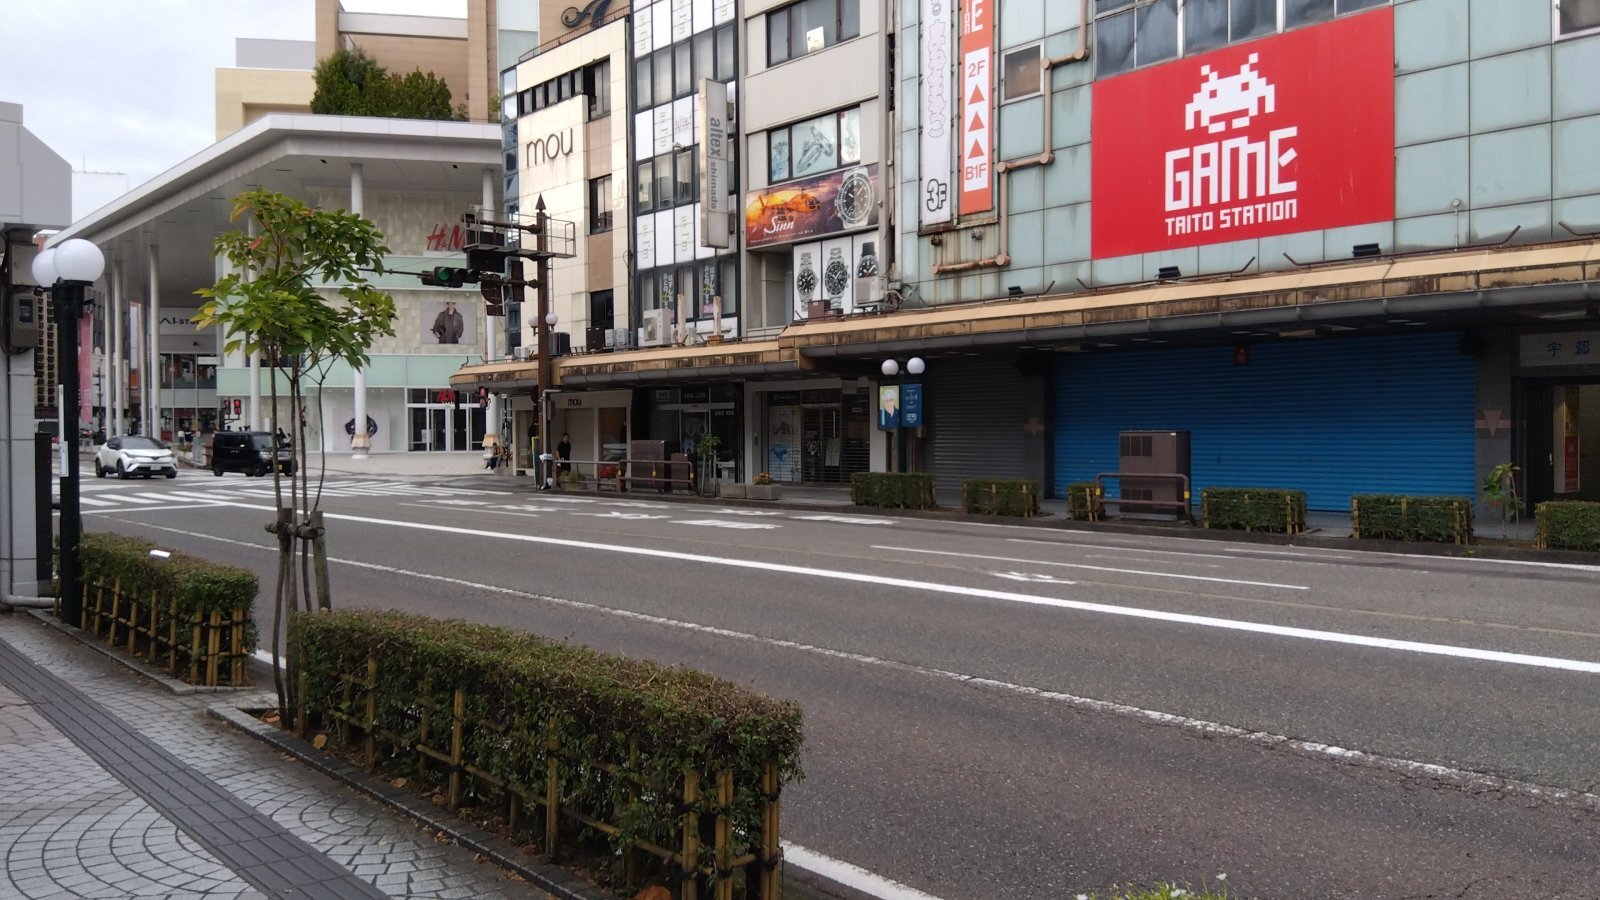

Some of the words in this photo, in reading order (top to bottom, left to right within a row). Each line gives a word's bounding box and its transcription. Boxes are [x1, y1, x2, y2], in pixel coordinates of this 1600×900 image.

[968, 60, 986, 78] 2F
[527, 127, 573, 167] mou
[710, 117, 723, 157] altex
[710, 161, 719, 209] shimada
[964, 163, 988, 181] B1F
[1165, 126, 1298, 212] GAME
[926, 178, 948, 212] 3F
[764, 216, 795, 234] Sinn
[1165, 211, 1214, 236] TAITO
[1219, 199, 1297, 229] STATION
[567, 398, 582, 407] mou
